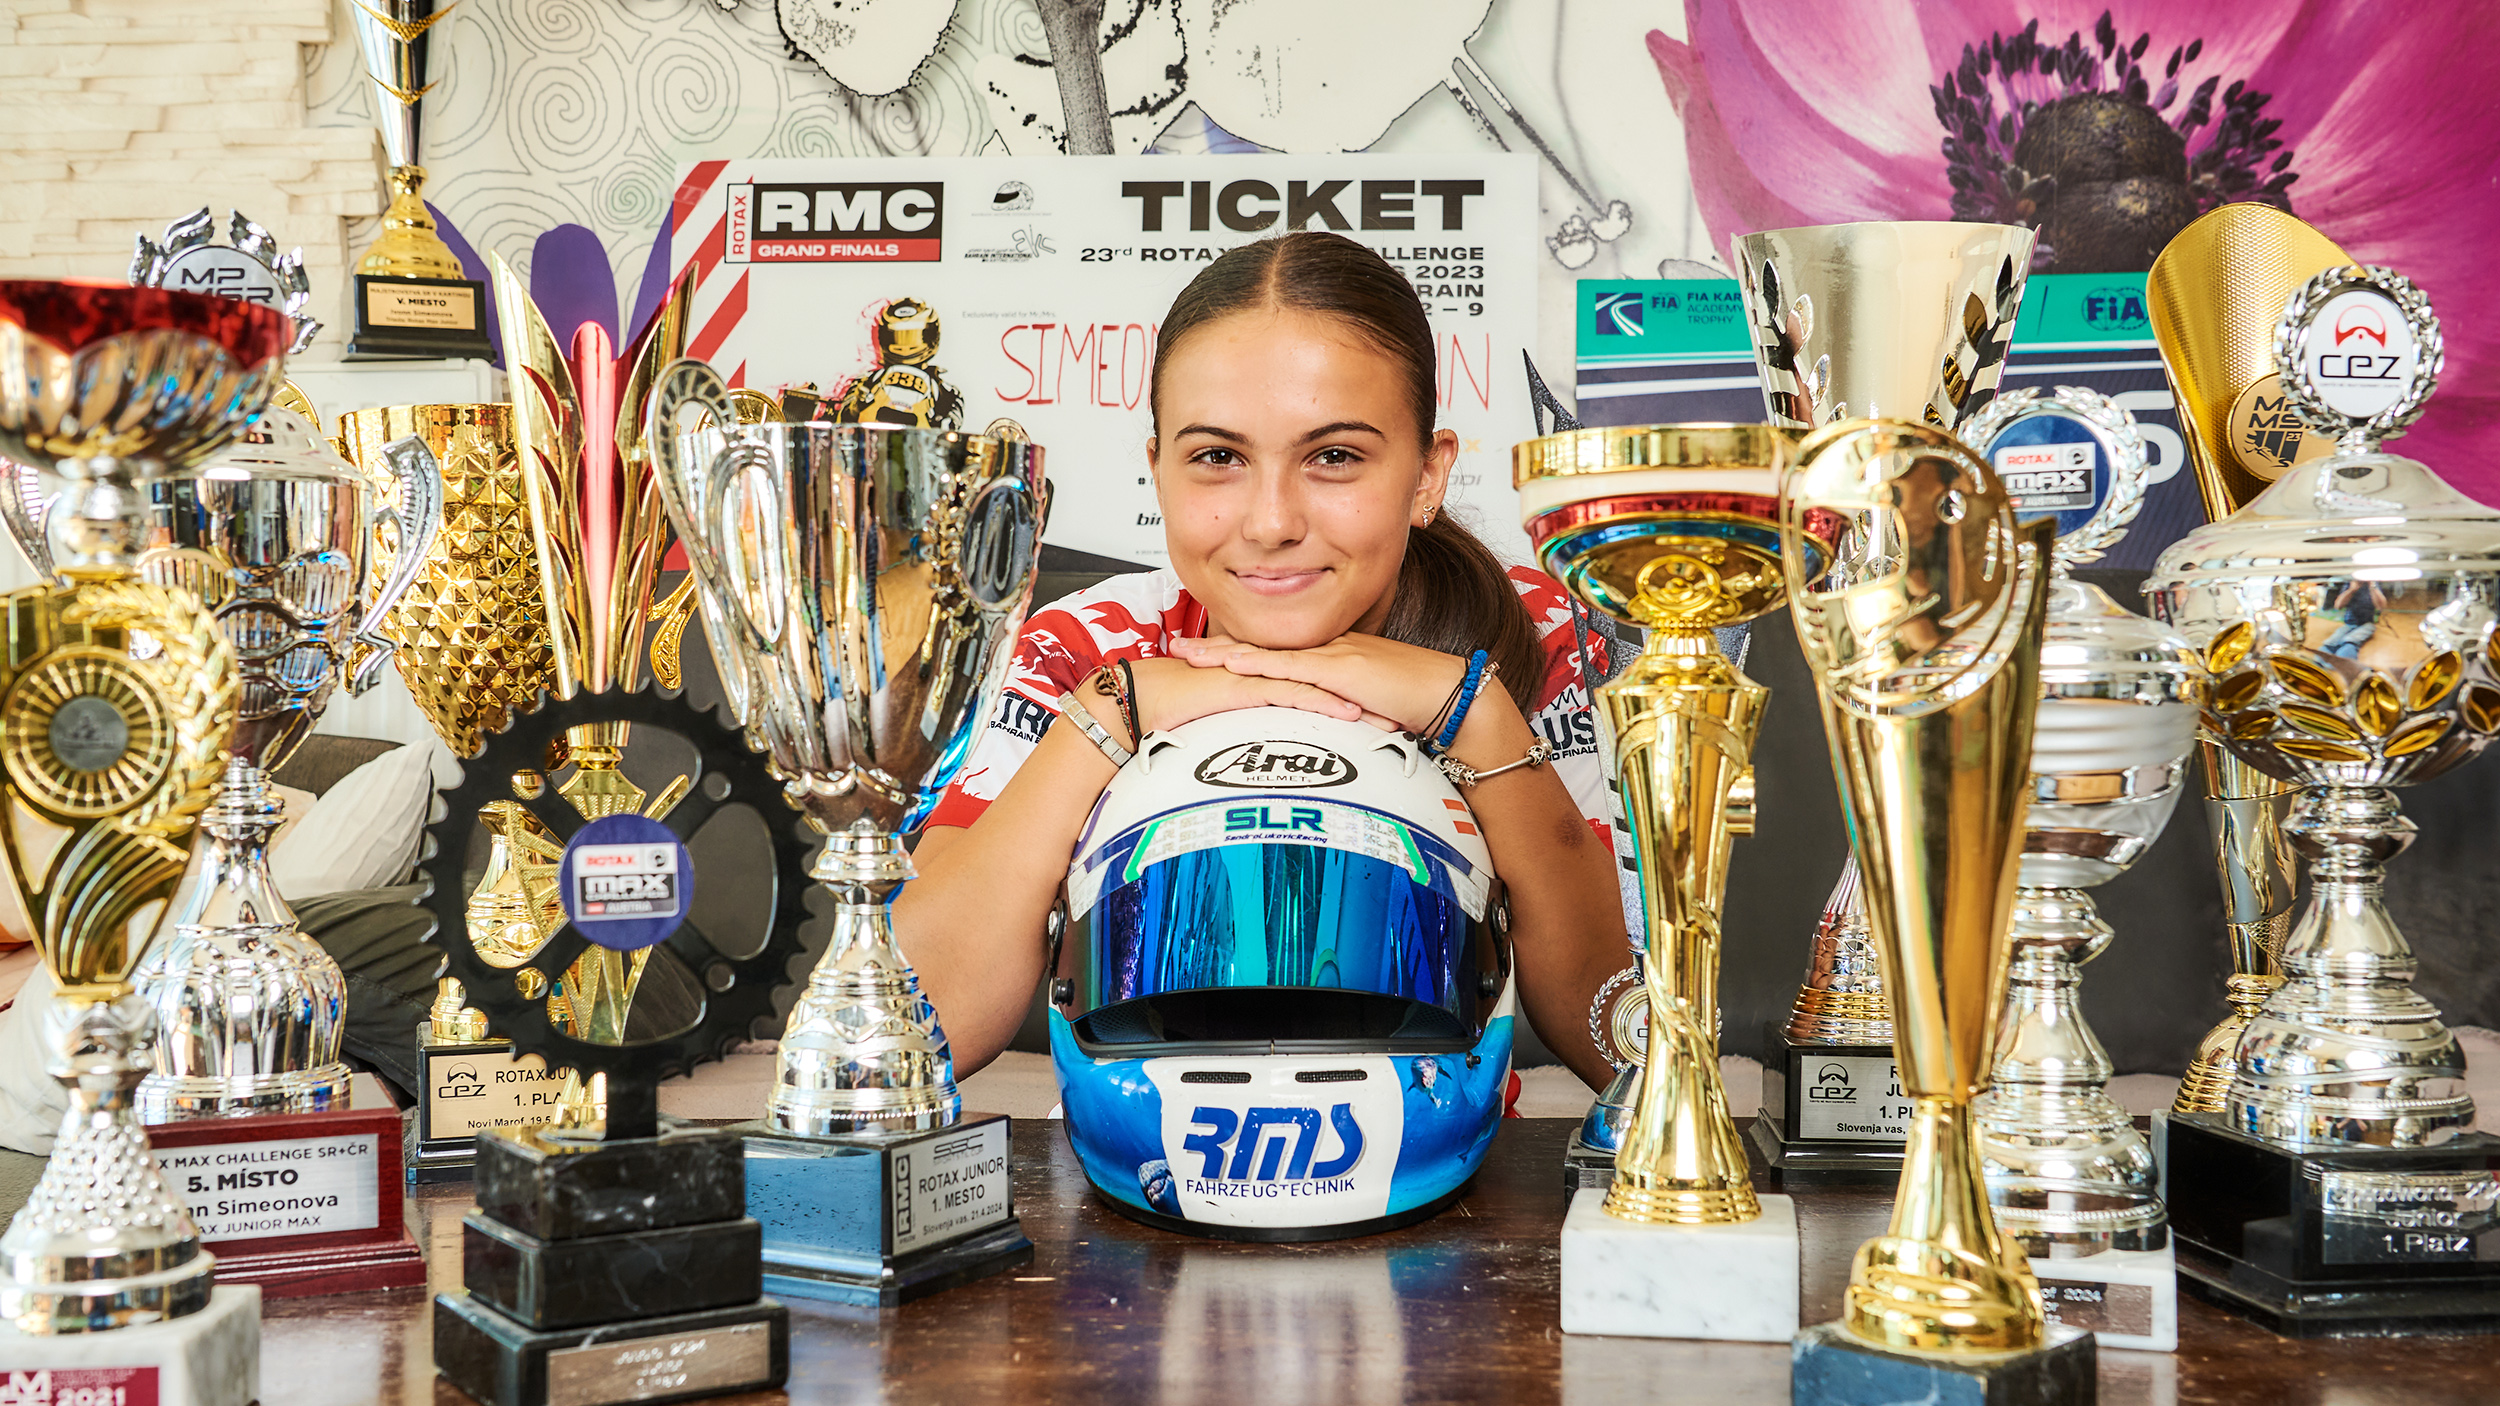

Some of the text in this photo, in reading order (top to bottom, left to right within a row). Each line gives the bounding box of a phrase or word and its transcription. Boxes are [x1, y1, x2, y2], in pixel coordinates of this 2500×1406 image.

[760, 189, 935, 232] RMC
[1121, 179, 1485, 232] TICKET
[732, 195, 747, 255] ROTAX
[758, 244, 899, 257] GRAND FINALS
[1080, 247, 1133, 262] 23rd
[1367, 248, 1484, 260] LLENGE
[181, 268, 245, 284] MP
[1416, 266, 1484, 278] 2023
[1414, 285, 1484, 297] RAIN
[1687, 292, 1743, 301] FIA KAR
[408, 298, 447, 307] MIESTO
[1468, 303, 1484, 316] 9
[1688, 315, 1734, 325] TROPHY
[995, 323, 1154, 411] SIMEO
[885, 371, 928, 395] 339
[2007, 454, 2056, 466] ROTAX
[1204, 744, 1341, 780] Arai
[1224, 806, 1327, 833] SLR
[495, 1068, 546, 1083] ROTAX
[513, 1092, 561, 1106] 1. PLA
[1879, 1105, 1892, 1119] 1.
[467, 1119, 492, 1129] Novi
[1836, 1122, 1906, 1135] Slovenja vas,
[175, 1155, 210, 1168] MAX
[216, 1148, 312, 1166] CHALLENGE
[187, 1169, 299, 1193] 5. MÍSTO
[919, 1169, 959, 1194] ROTAX
[962, 1156, 1004, 1182] JUNIOR
[1186, 1178, 1355, 1198] FAHRZEUGTECHNIK
[217, 1194, 339, 1216] Simeonova
[932, 1184, 985, 1213] 1. MESTO
[222, 1219, 282, 1235] JUNIOR
[287, 1216, 321, 1228] MAX
[2404, 1233, 2470, 1253] Platz
